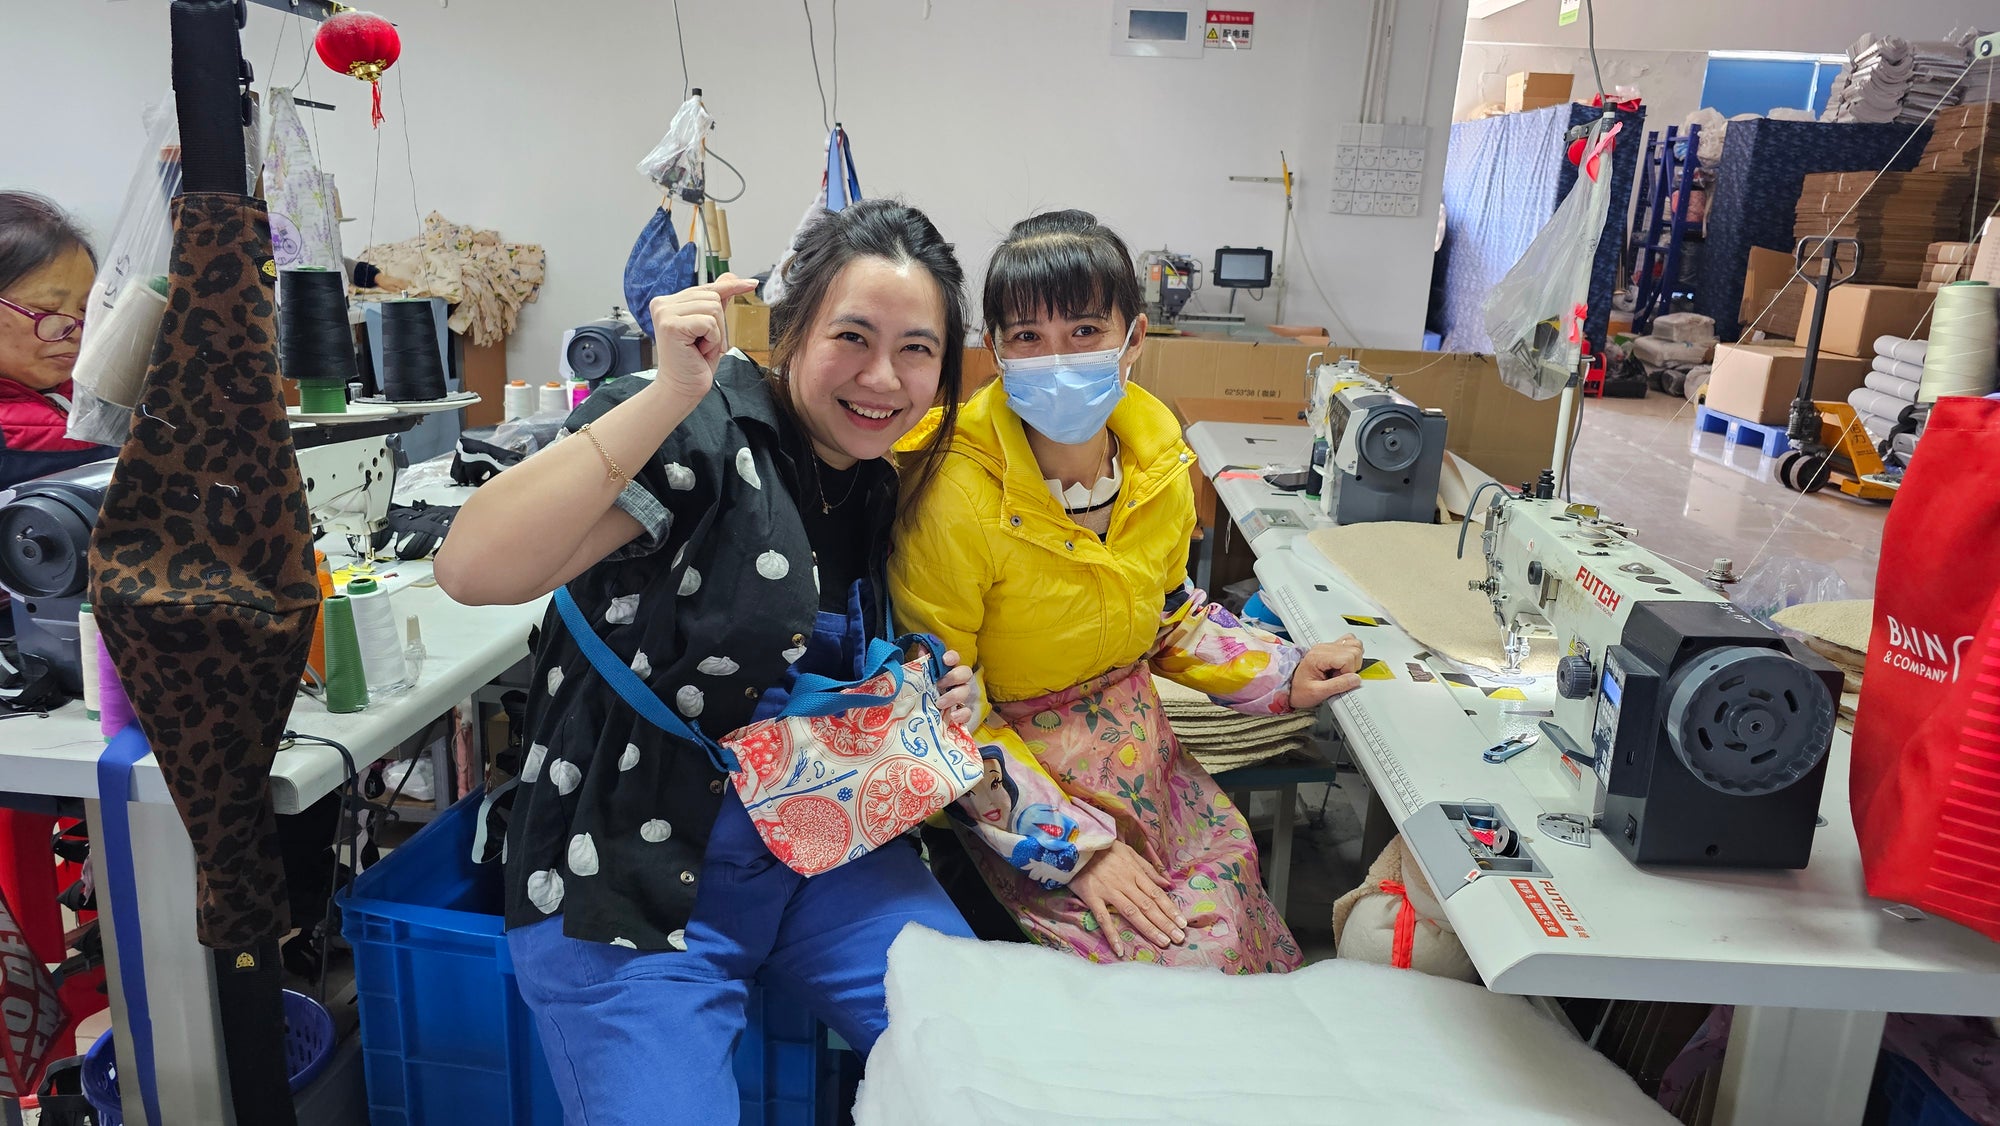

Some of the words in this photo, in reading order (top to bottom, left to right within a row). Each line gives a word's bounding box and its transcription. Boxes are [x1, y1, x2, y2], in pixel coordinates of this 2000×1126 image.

[1575, 565, 1621, 612] FUTCH
[1887, 615, 1948, 665] BAIN
[1883, 650, 1892, 664] &
[1893, 653, 1948, 684] COMPANY
[1539, 880, 1578, 921] FUTCH
